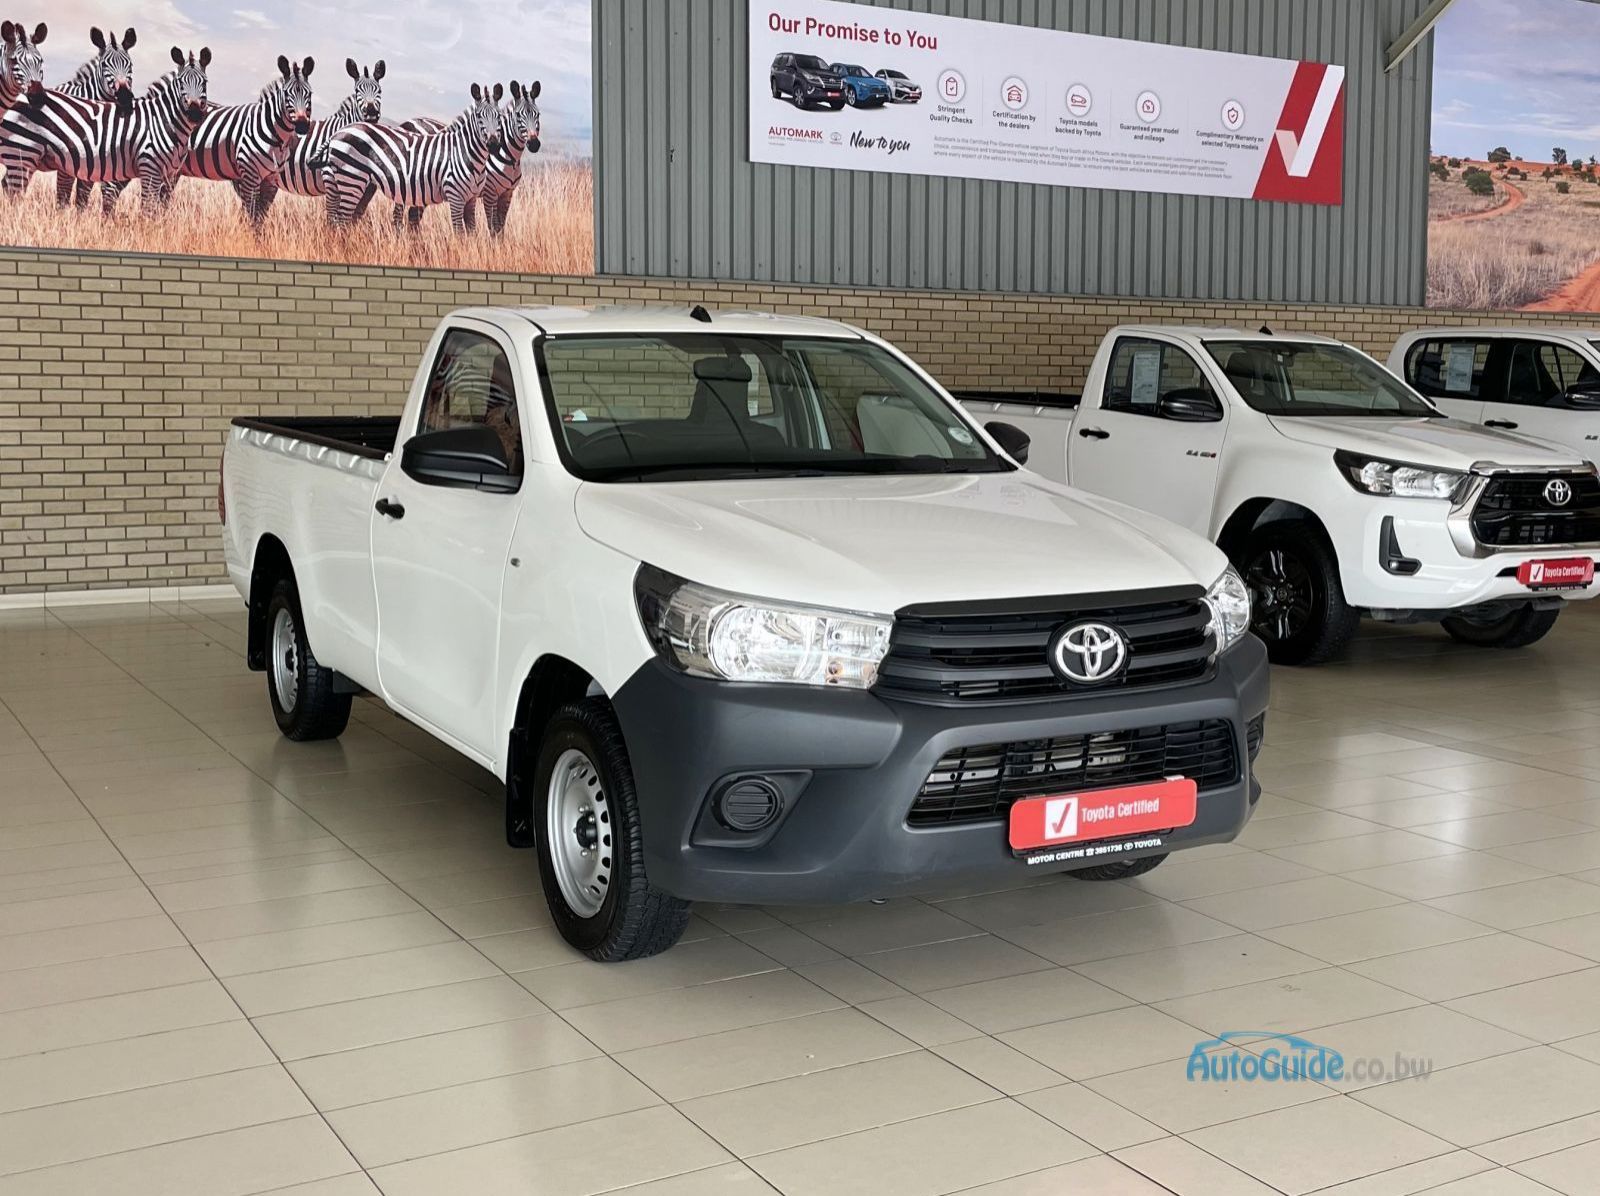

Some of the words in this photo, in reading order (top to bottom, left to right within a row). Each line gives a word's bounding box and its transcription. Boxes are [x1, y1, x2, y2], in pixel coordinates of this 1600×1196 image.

[769, 13, 801, 33] Our
[806, 17, 879, 43] Promise
[884, 28, 902, 45] to
[906, 30, 937, 50] You
[937, 105, 965, 114] Stringent
[930, 114, 950, 123] Quality
[951, 115, 973, 124] Checks
[992, 111, 1028, 121] Certification
[1029, 114, 1036, 122] by
[1059, 117, 1077, 127] Toyota
[1078, 119, 1098, 127] models
[1008, 121, 1030, 130] dealers
[1119, 123, 1150, 132] Guaranteed
[1150, 126, 1162, 135] year
[768, 126, 823, 139] AUTOMARK
[1055, 126, 1075, 135] backed
[1076, 128, 1083, 136] by
[1084, 128, 1102, 137] Toyota
[849, 130, 875, 148] New
[875, 136, 887, 149] to
[888, 141, 910, 155] you
[1145, 134, 1165, 143] mileage
[1224, 141, 1240, 150] Toyota
[1544, 567, 1562, 578] Toyota
[1563, 566, 1585, 577] Certified
[1082, 806, 1115, 823] Toyota
[1117, 798, 1160, 817] Certified
[1027, 854, 1055, 865] MOTOR
[1056, 850, 1084, 861] CENTRE
[1134, 838, 1162, 849] TOYOTA
